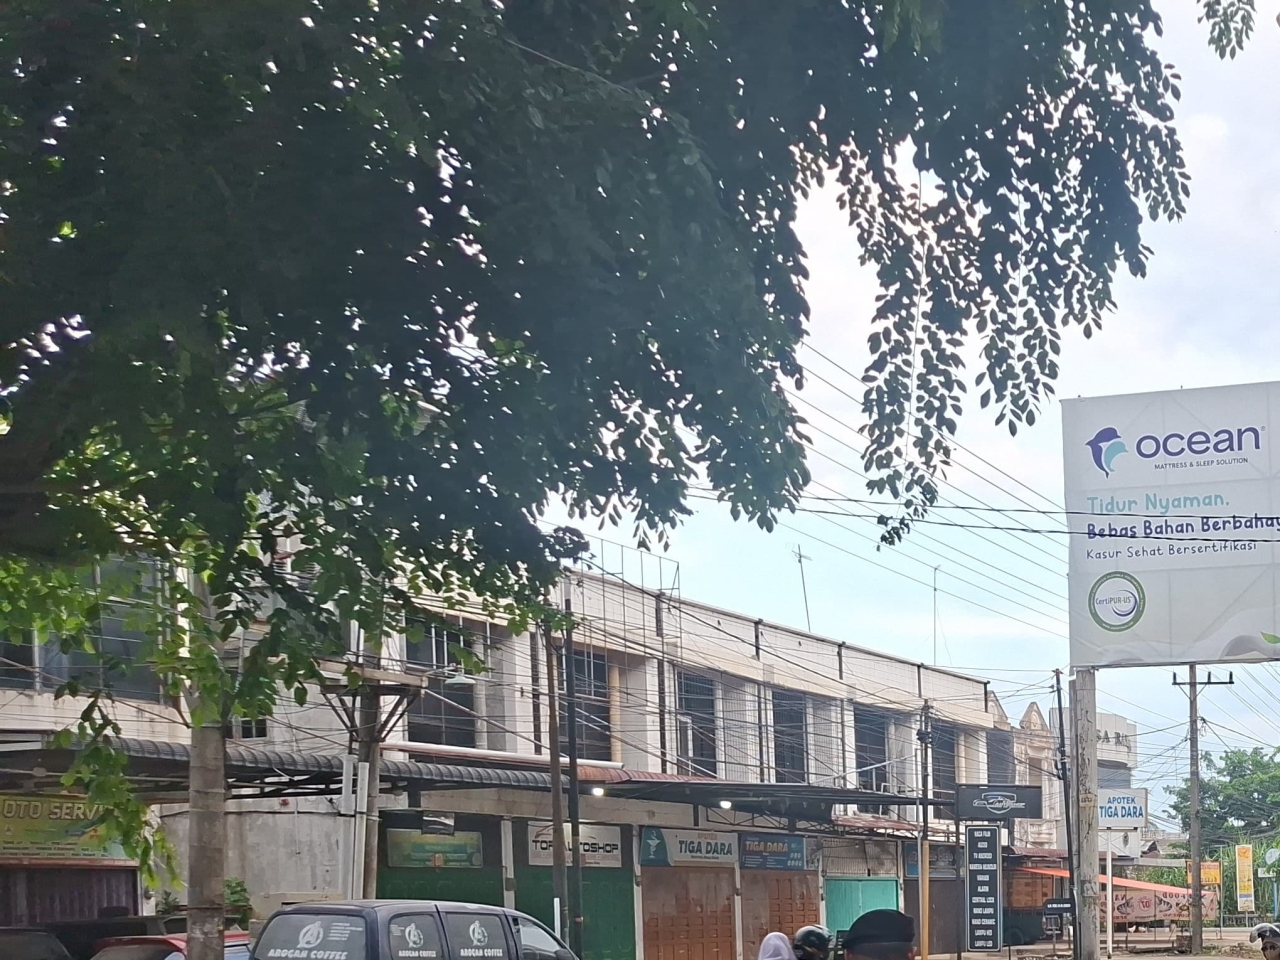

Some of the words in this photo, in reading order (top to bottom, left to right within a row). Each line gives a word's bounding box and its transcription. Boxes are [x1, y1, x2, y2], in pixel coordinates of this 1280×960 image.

[1136, 427, 1260, 459] ocean
[1154, 461, 1188, 470] MATTRESS
[1195, 460, 1215, 468] SLEEP
[1216, 457, 1249, 466] SOLUTION
[1087, 496, 1138, 514] Tidur
[1145, 493, 1230, 514] Nyaman.
[1087, 523, 1138, 540] Bebas
[1143, 519, 1195, 536] Bahan
[1086, 549, 1122, 560] Kasur
[1127, 544, 1164, 558] Sehat
[1168, 540, 1257, 556] Bersertifikasi
[1107, 796, 1136, 805] APOTEK
[1099, 805, 1119, 818] TIGA
[1121, 805, 1144, 818] DARA
[679, 840, 703, 854] TIGA
[705, 842, 733, 856] DARA
[745, 840, 765, 851] TIGA
[767, 842, 788, 853] DARA
[310, 950, 349, 960] COFFEE
[484, 948, 503, 957] COFFEE
